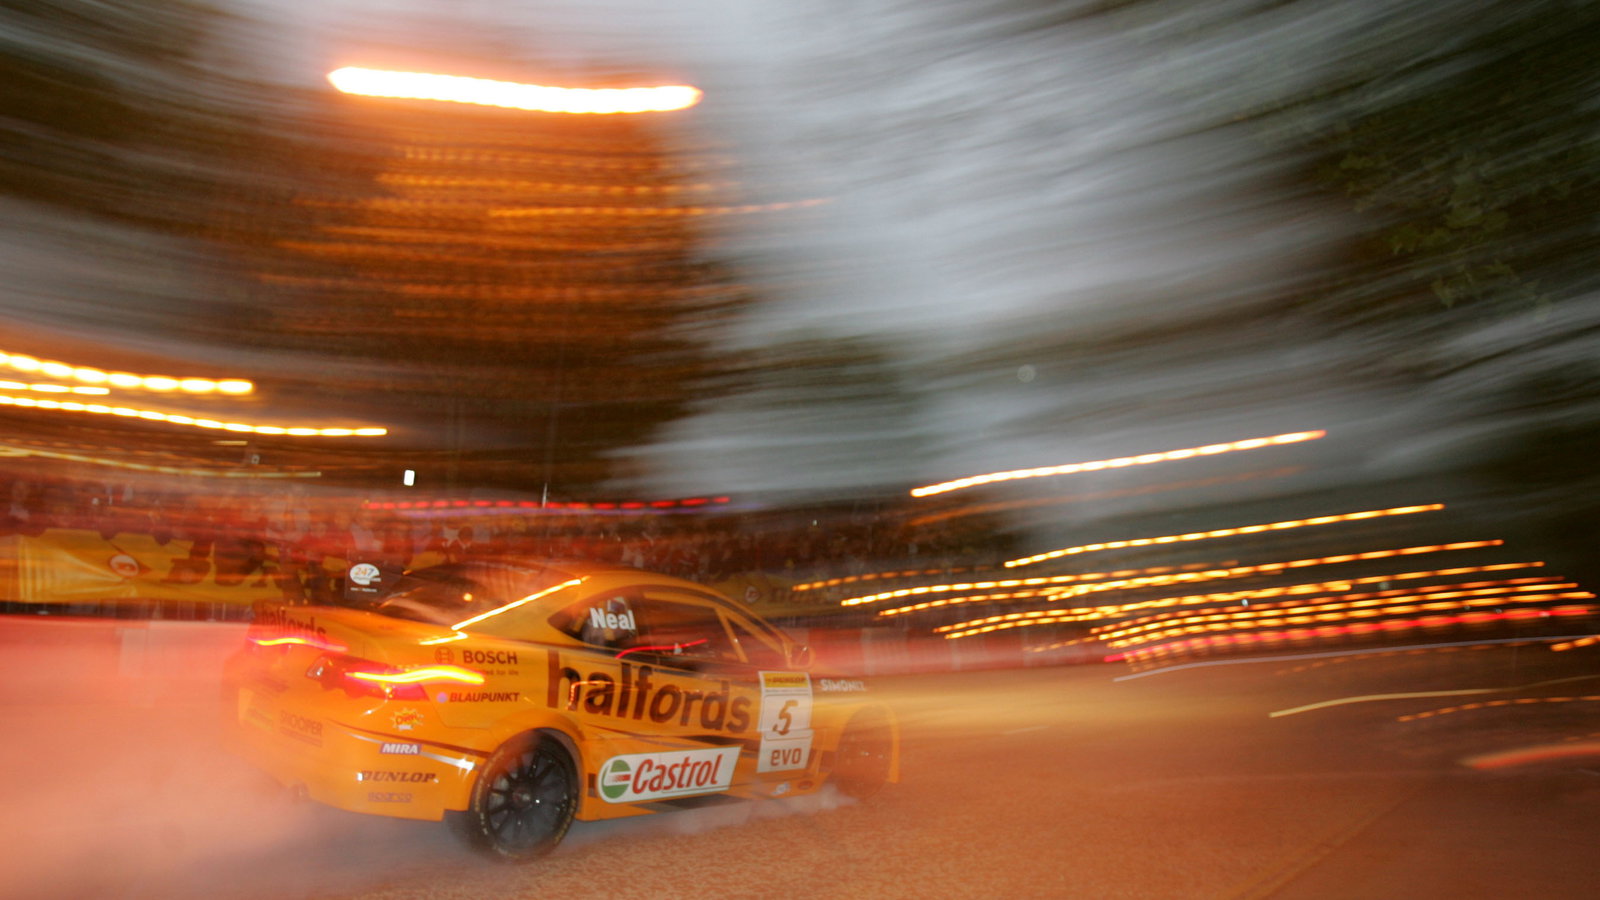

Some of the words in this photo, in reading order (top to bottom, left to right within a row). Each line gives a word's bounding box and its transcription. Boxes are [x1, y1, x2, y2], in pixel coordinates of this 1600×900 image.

[589, 607, 635, 630] Neal
[463, 650, 518, 664] BOSCH
[450, 692, 519, 702] BLAUPUNKT
[547, 648, 752, 734] halfords
[772, 700, 798, 735] 5
[382, 743, 418, 754] MIRA
[771, 748, 801, 766] evo
[361, 771, 436, 782] DUNLOP
[632, 754, 723, 794] Castrol
